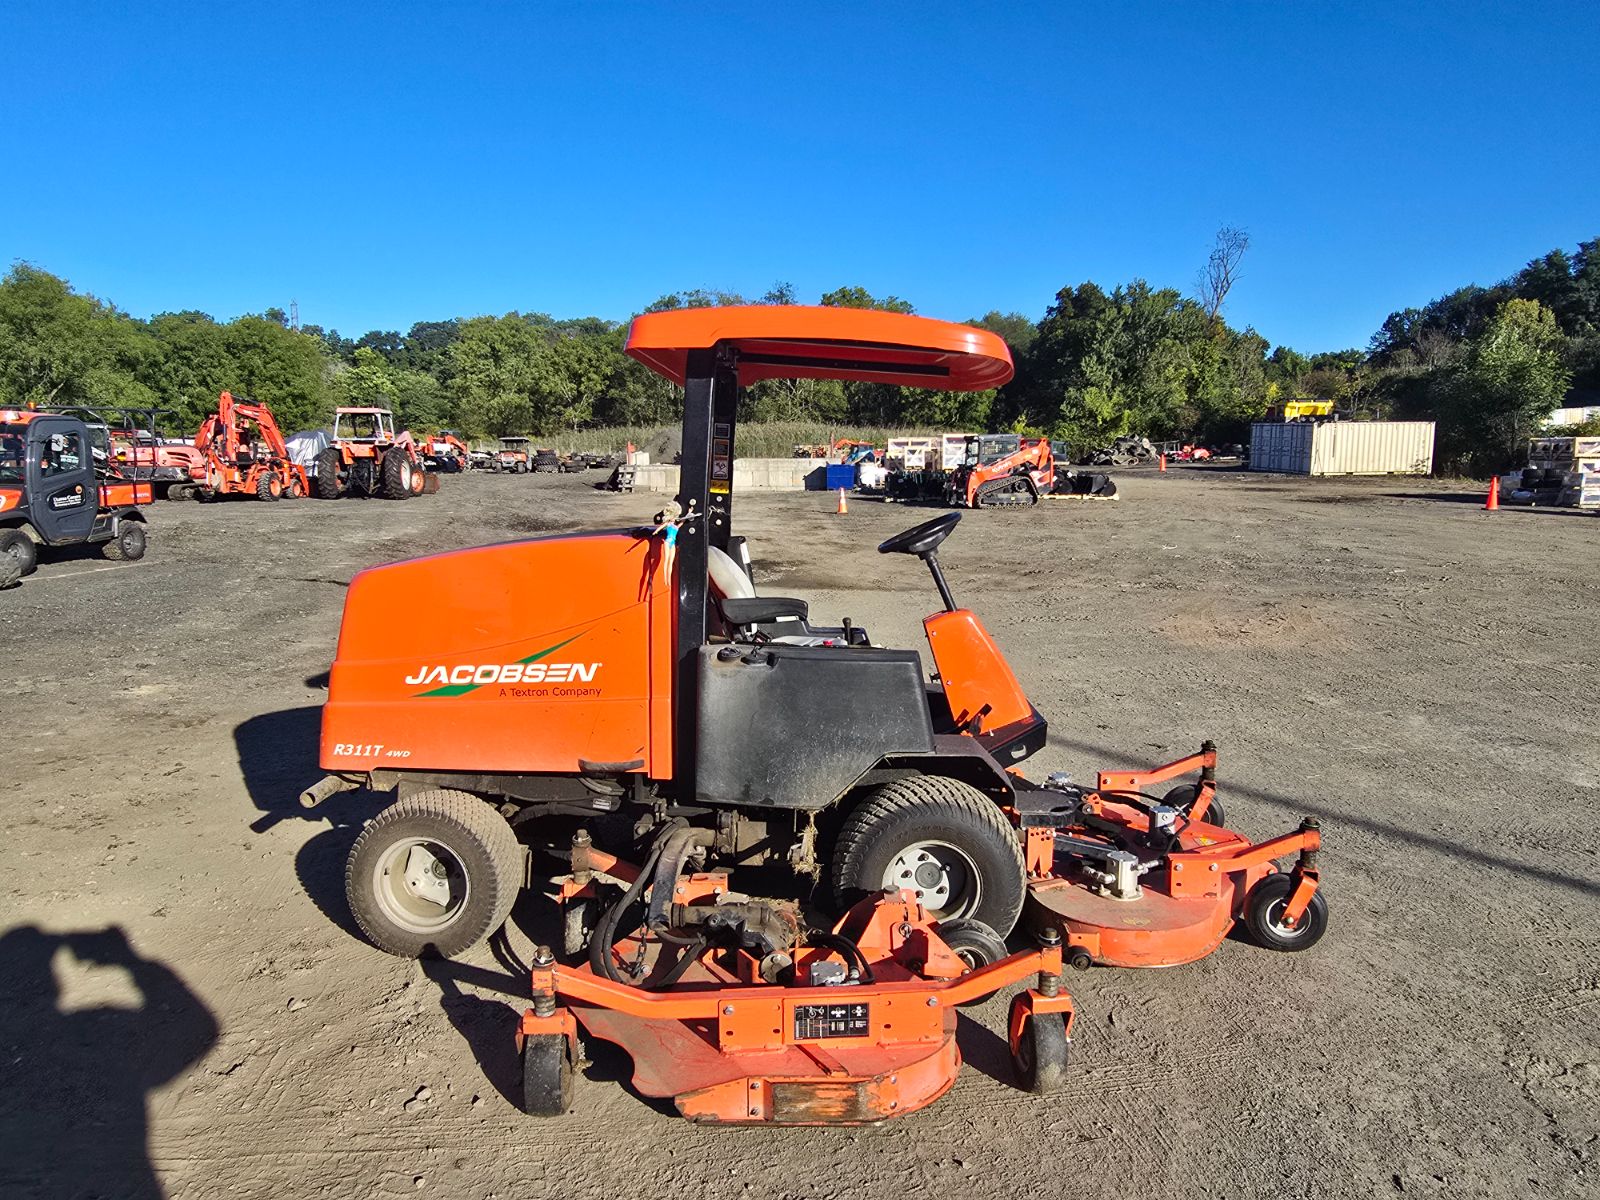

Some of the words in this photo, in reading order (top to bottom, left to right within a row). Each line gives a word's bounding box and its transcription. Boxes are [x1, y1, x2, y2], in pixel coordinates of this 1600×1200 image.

[405, 662, 599, 685] JACOBSEN
[499, 688, 507, 697] A
[510, 687, 549, 698] Textron
[552, 687, 602, 699] Company
[333, 743, 384, 757] R311T
[386, 750, 411, 758] 4WD
